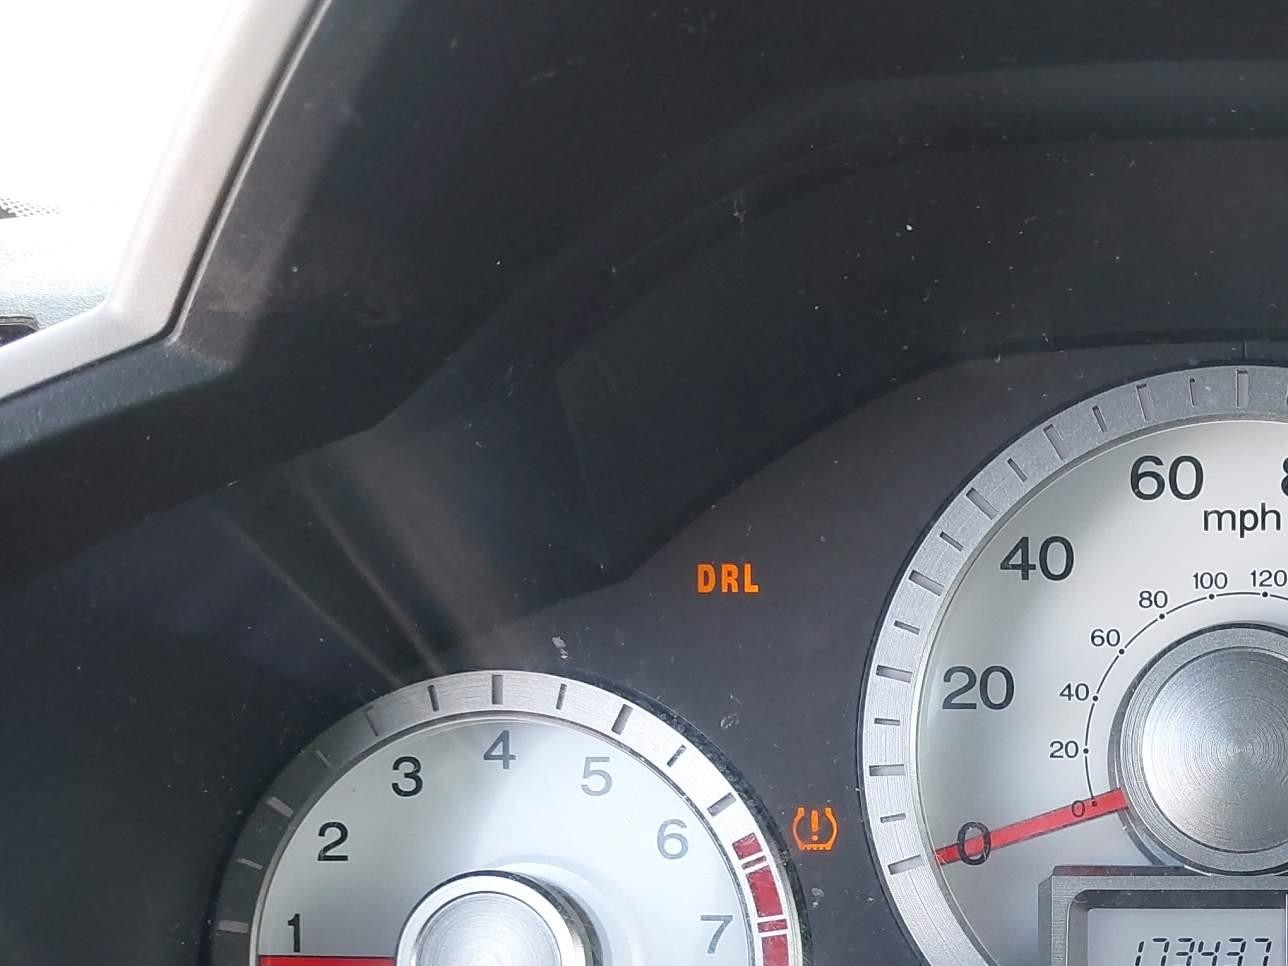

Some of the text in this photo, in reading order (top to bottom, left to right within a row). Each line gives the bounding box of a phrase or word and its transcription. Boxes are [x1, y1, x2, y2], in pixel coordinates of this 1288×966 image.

[1131, 456, 1203, 500] 60
[1204, 503, 1280, 538] mph
[1000, 536, 1075, 581] 40
[698, 564, 758, 593] DRL
[1192, 571, 1228, 591] 100
[1249, 568, 1288, 589] 120
[1137, 589, 1169, 609] 80
[1089, 628, 1122, 649] 60
[943, 666, 1014, 710] 20
[1060, 683, 1089, 700] 40
[483, 729, 517, 770] 4
[1050, 741, 1078, 758] 20
[392, 756, 422, 797] 3
[581, 757, 612, 796] 5
[1071, 799, 1087, 819] 0
[318, 822, 348, 861] 2
[657, 819, 688, 860] 6
[957, 822, 992, 865] 0
[288, 913, 301, 952] 1
[701, 915, 733, 954] 7
